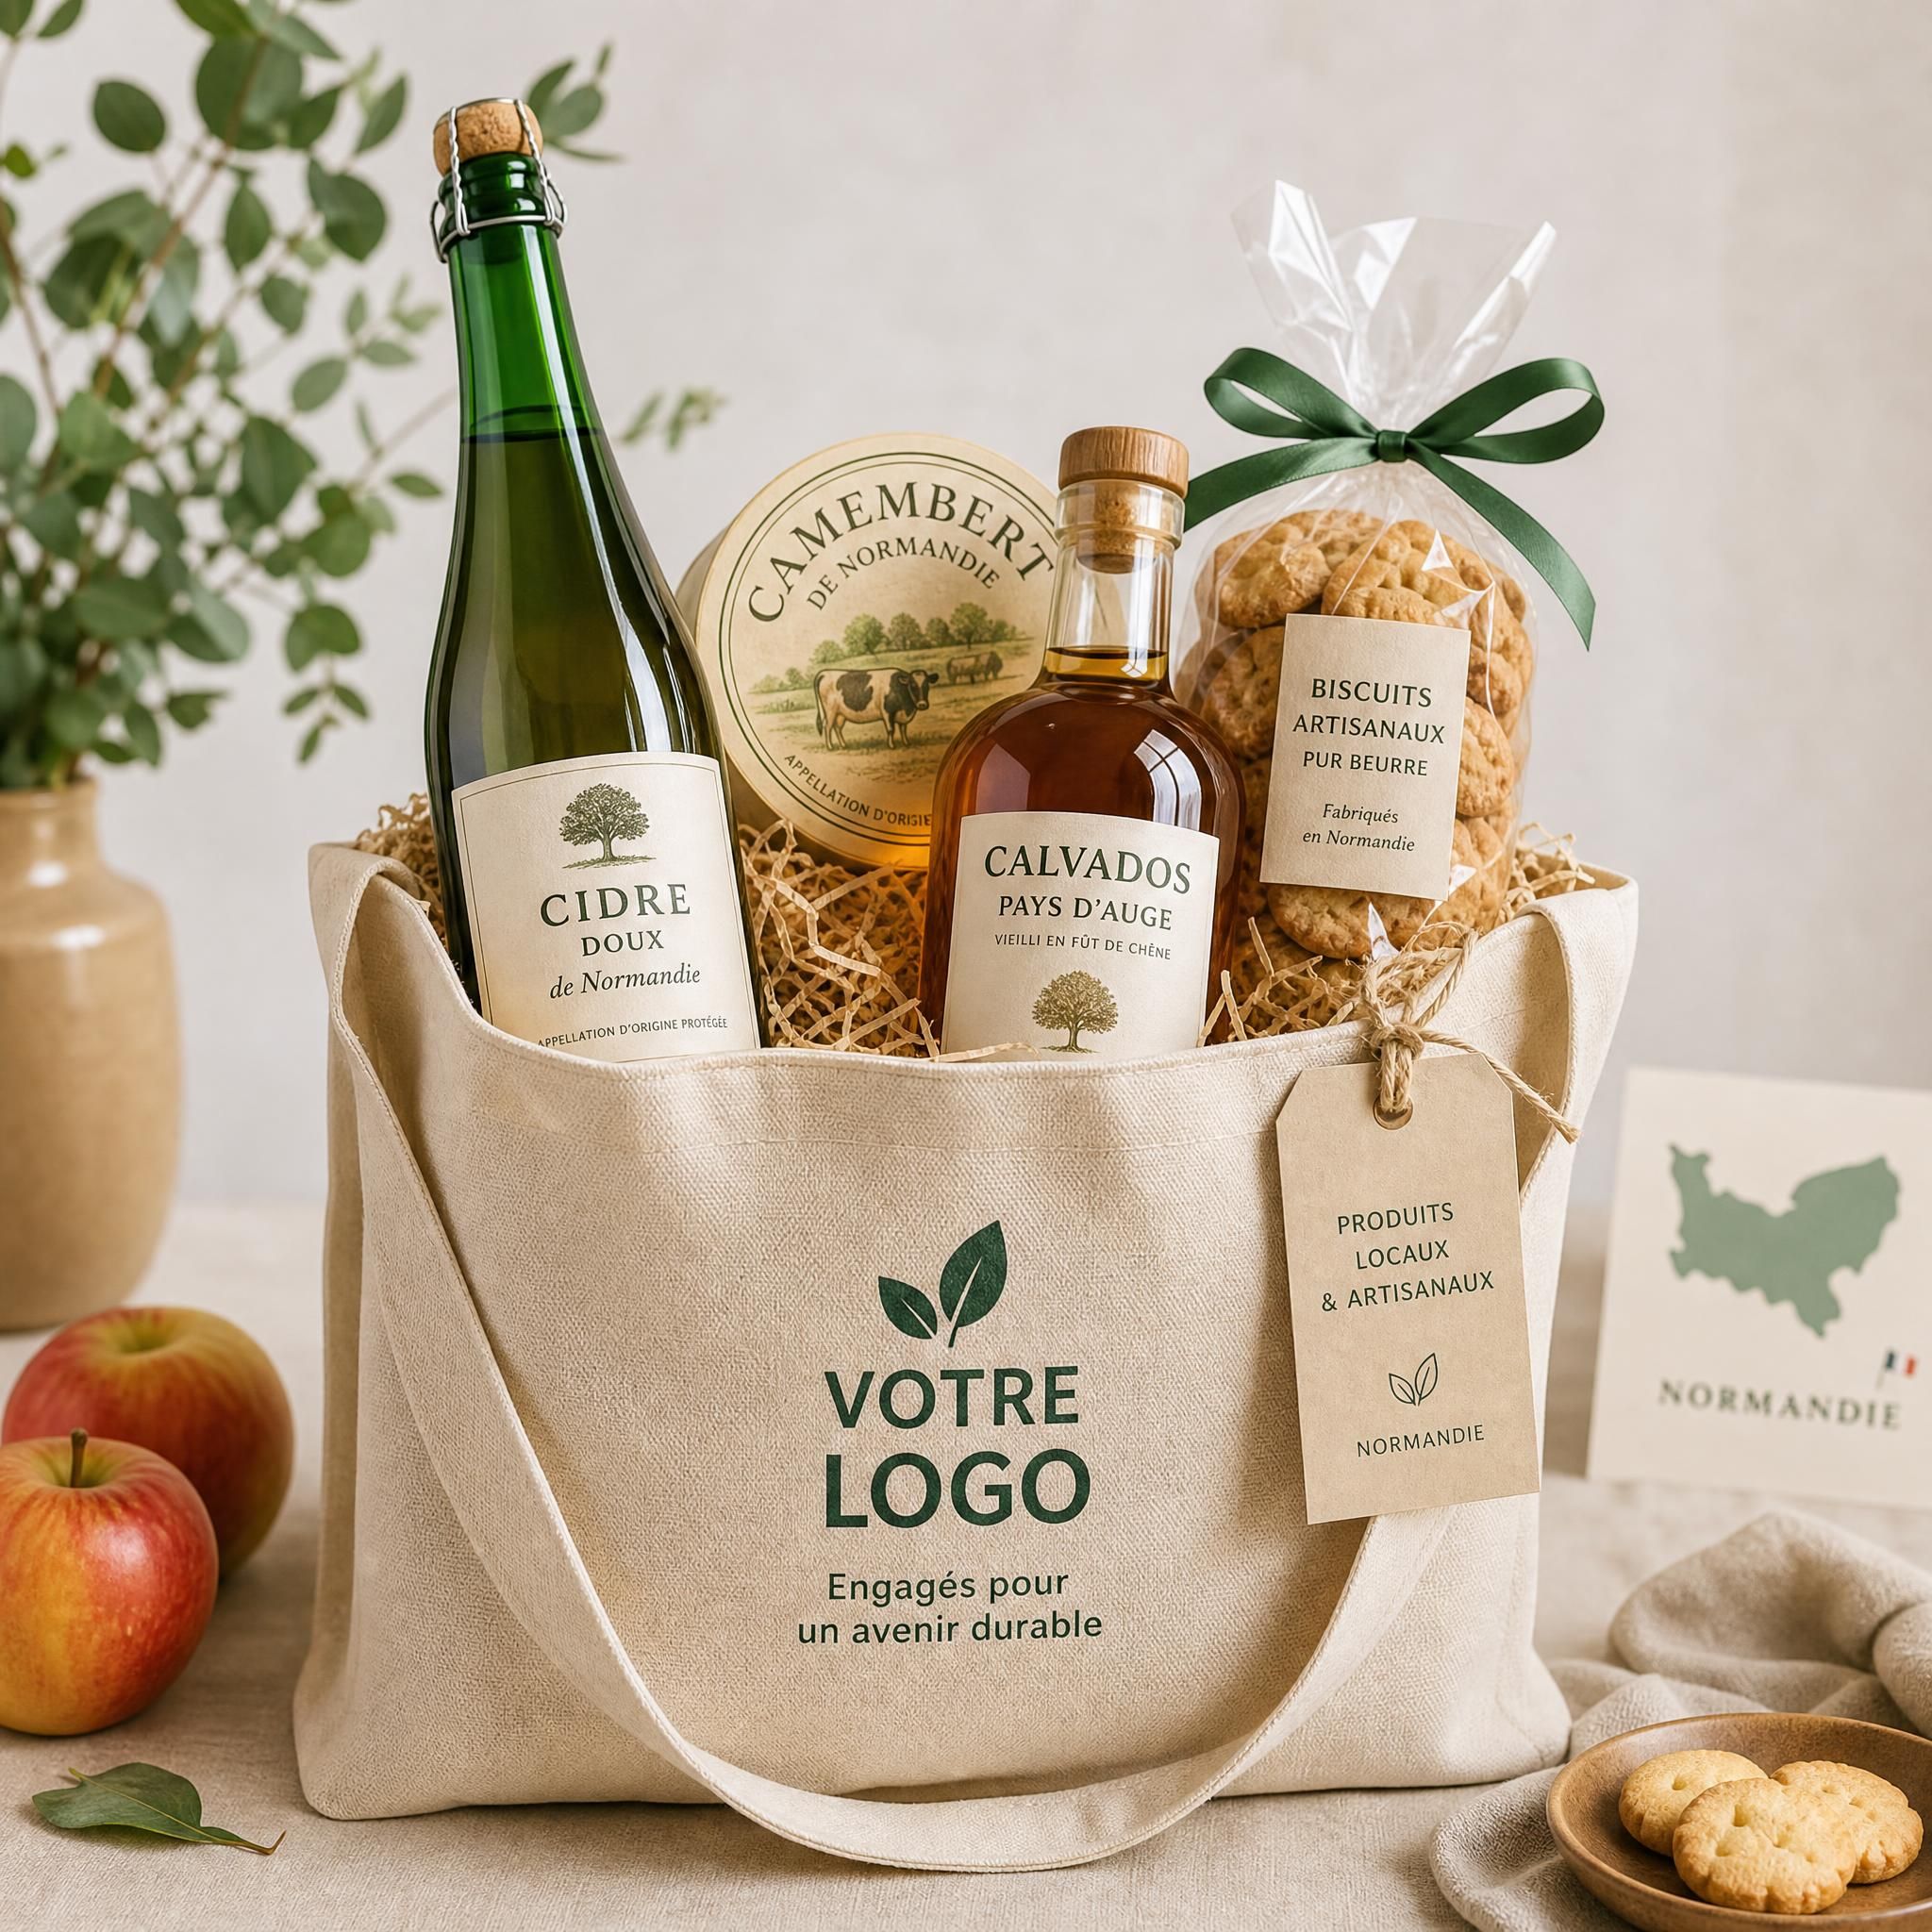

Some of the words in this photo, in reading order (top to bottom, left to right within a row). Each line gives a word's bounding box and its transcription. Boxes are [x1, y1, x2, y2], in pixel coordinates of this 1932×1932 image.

[748, 481, 1055, 623] CAMEMBERT
[807, 574, 839, 611] DE
[837, 536, 1001, 590] NORMANDIE
[1310, 678, 1432, 708] BISCUITS
[1292, 714, 1445, 743] ARTISANAUX
[1303, 751, 1342, 769] PUR
[1349, 755, 1428, 776] BEURRE
[785, 755, 870, 816] APPELLATION
[1323, 804, 1399, 825] Fabriqués
[1303, 832, 1322, 843] en
[1326, 830, 1415, 852] Normandie
[984, 845, 1191, 894] CALVADOS
[540, 883, 691, 927] CIDRE
[998, 896, 1062, 917] PAYS
[1073, 897, 1173, 930] D'AUGE
[581, 930, 664, 957] DOUX
[994, 934, 1041, 946] VIEILLI
[1046, 935, 1065, 947] EN
[1072, 934, 1100, 949] FÛT
[1105, 940, 1124, 952] DE
[549, 975, 574, 999] de
[580, 962, 701, 993] Normandie
[1337, 1202, 1454, 1235] PRODUITS
[1356, 1240, 1450, 1270] LOCAUX
[1321, 1292, 1338, 1312] &
[1347, 1271, 1494, 1309] ARTISANAUX
[824, 1366, 1079, 1429] VOTRE
[1657, 1378, 1901, 1431] NORMANDIE
[1357, 1424, 1484, 1457] NORMANDIE
[825, 1449, 1091, 1528] LOGO
[828, 1571, 976, 1608] Engagés
[989, 1574, 1069, 1604] pour
[798, 1624, 839, 1643] un
[852, 1615, 958, 1643] avenir
[971, 1609, 1103, 1641] durable
